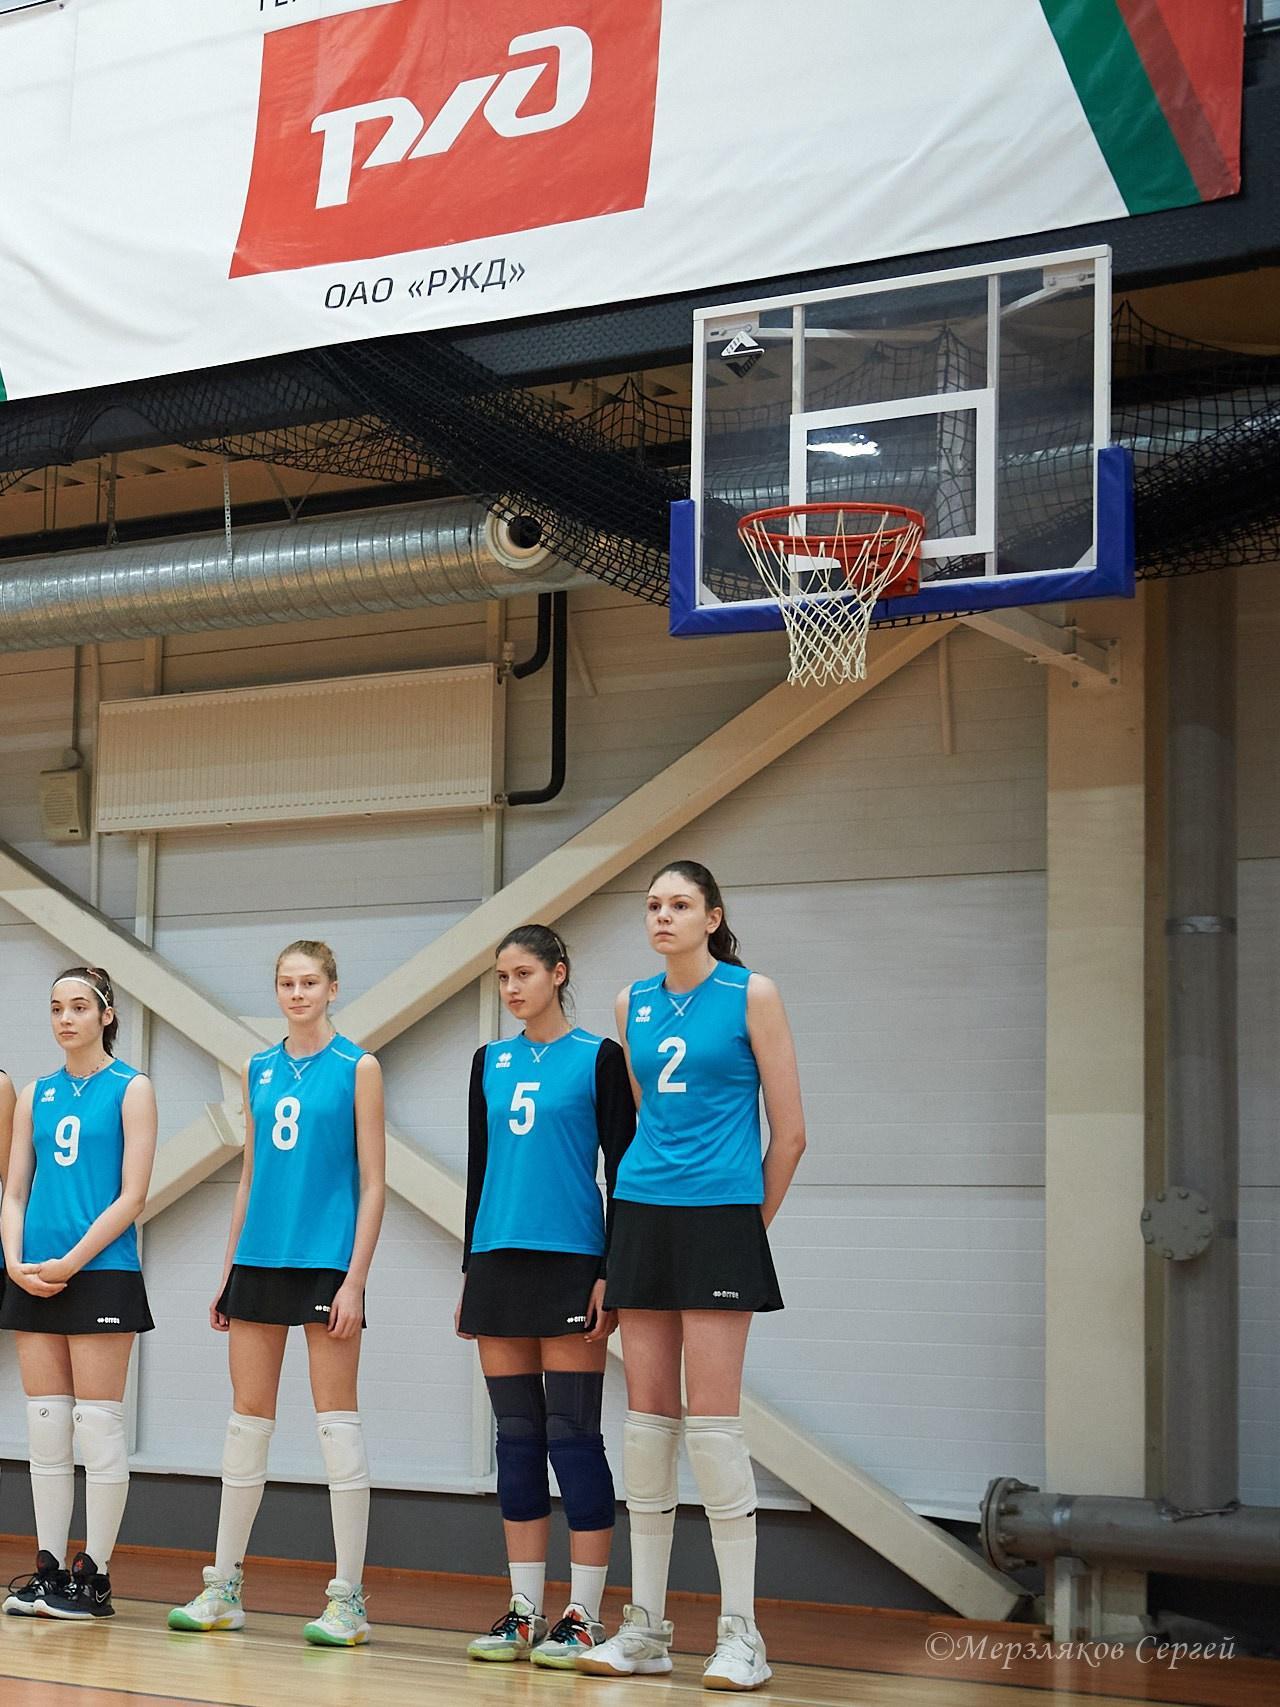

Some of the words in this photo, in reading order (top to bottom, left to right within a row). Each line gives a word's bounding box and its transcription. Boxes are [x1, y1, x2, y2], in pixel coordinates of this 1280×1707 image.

[324, 277, 394, 309] ОАО
[408, 257, 526, 298] «РЖД»
[657, 1036, 687, 1093] 2
[272, 1096, 301, 1151] 8
[508, 1082, 541, 1136] 5
[53, 1115, 81, 1167] 9
